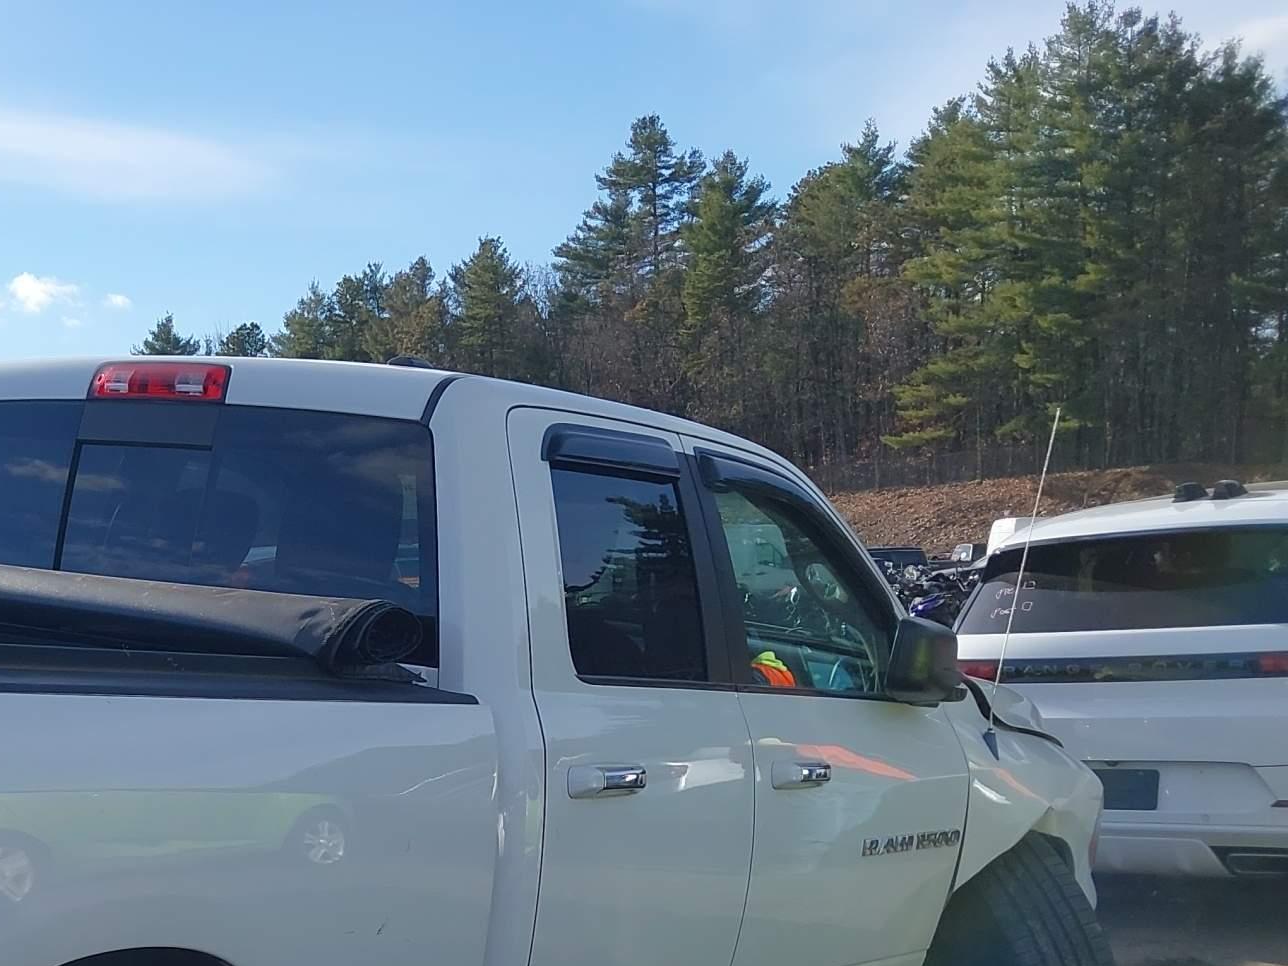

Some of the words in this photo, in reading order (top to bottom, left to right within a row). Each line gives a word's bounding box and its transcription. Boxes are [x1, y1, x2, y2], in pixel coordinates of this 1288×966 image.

[1002, 663, 1104, 677] RANGE
[1128, 658, 1245, 673] ROVER
[862, 835, 914, 857] RAM
